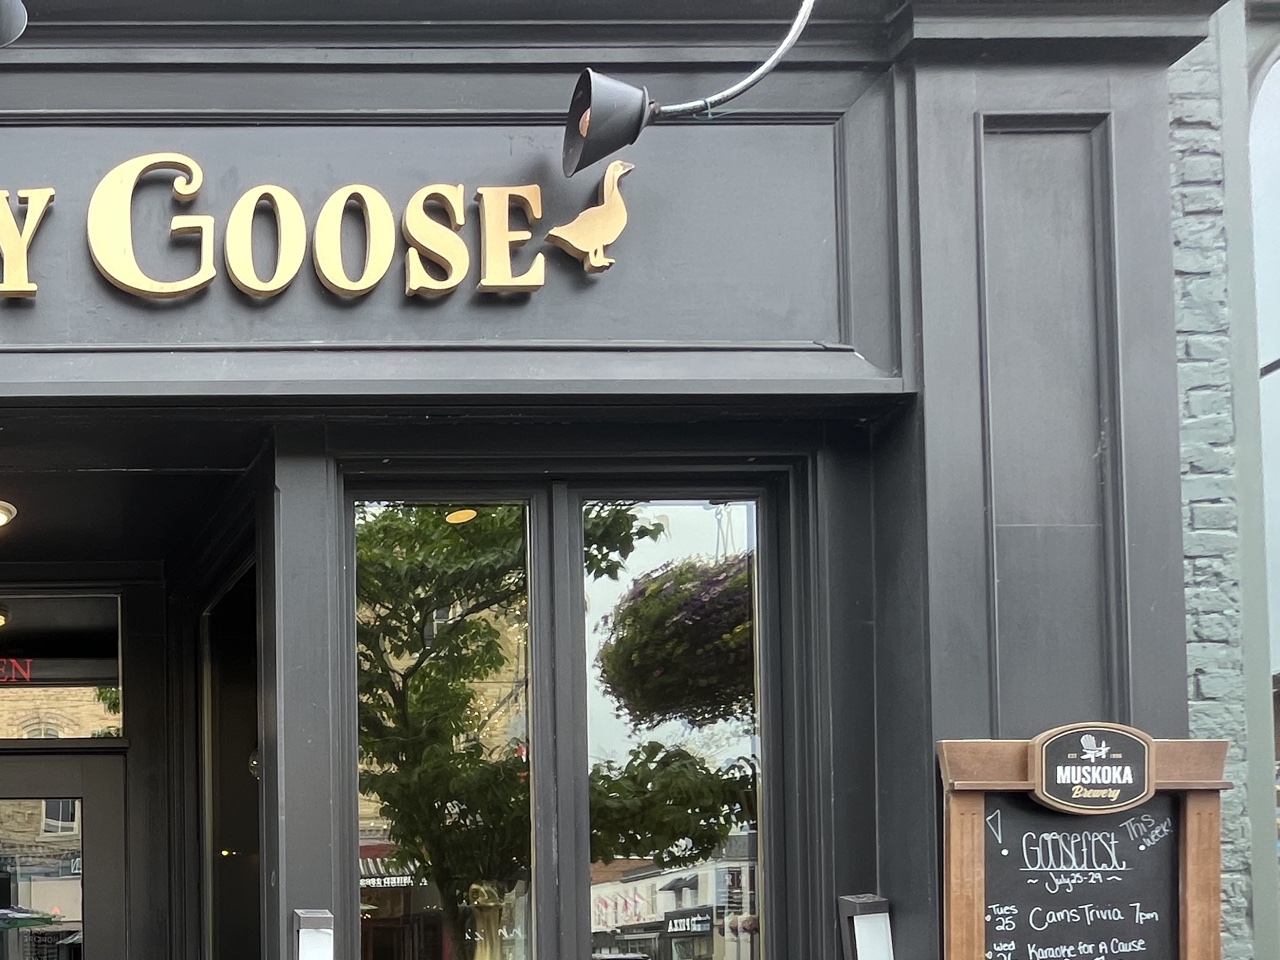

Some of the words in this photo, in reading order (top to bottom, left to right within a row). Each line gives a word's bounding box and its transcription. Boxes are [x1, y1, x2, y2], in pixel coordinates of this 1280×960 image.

[86, 152, 545, 298] GOOSE
[1056, 765, 1133, 784] MUSKOKA
[1071, 785, 1121, 802] Brewery
[1119, 813, 1155, 842] This
[1045, 872, 1073, 893] July
[988, 903, 1018, 915] Tues
[1029, 906, 1080, 931] Cams
[1079, 903, 1124, 925] Trivia
[1129, 902, 1159, 924] 7pm
[995, 915, 1016, 931] 25
[1077, 941, 1096, 955] for
[1099, 942, 1108, 954] A
[1111, 937, 1147, 953] Cause
